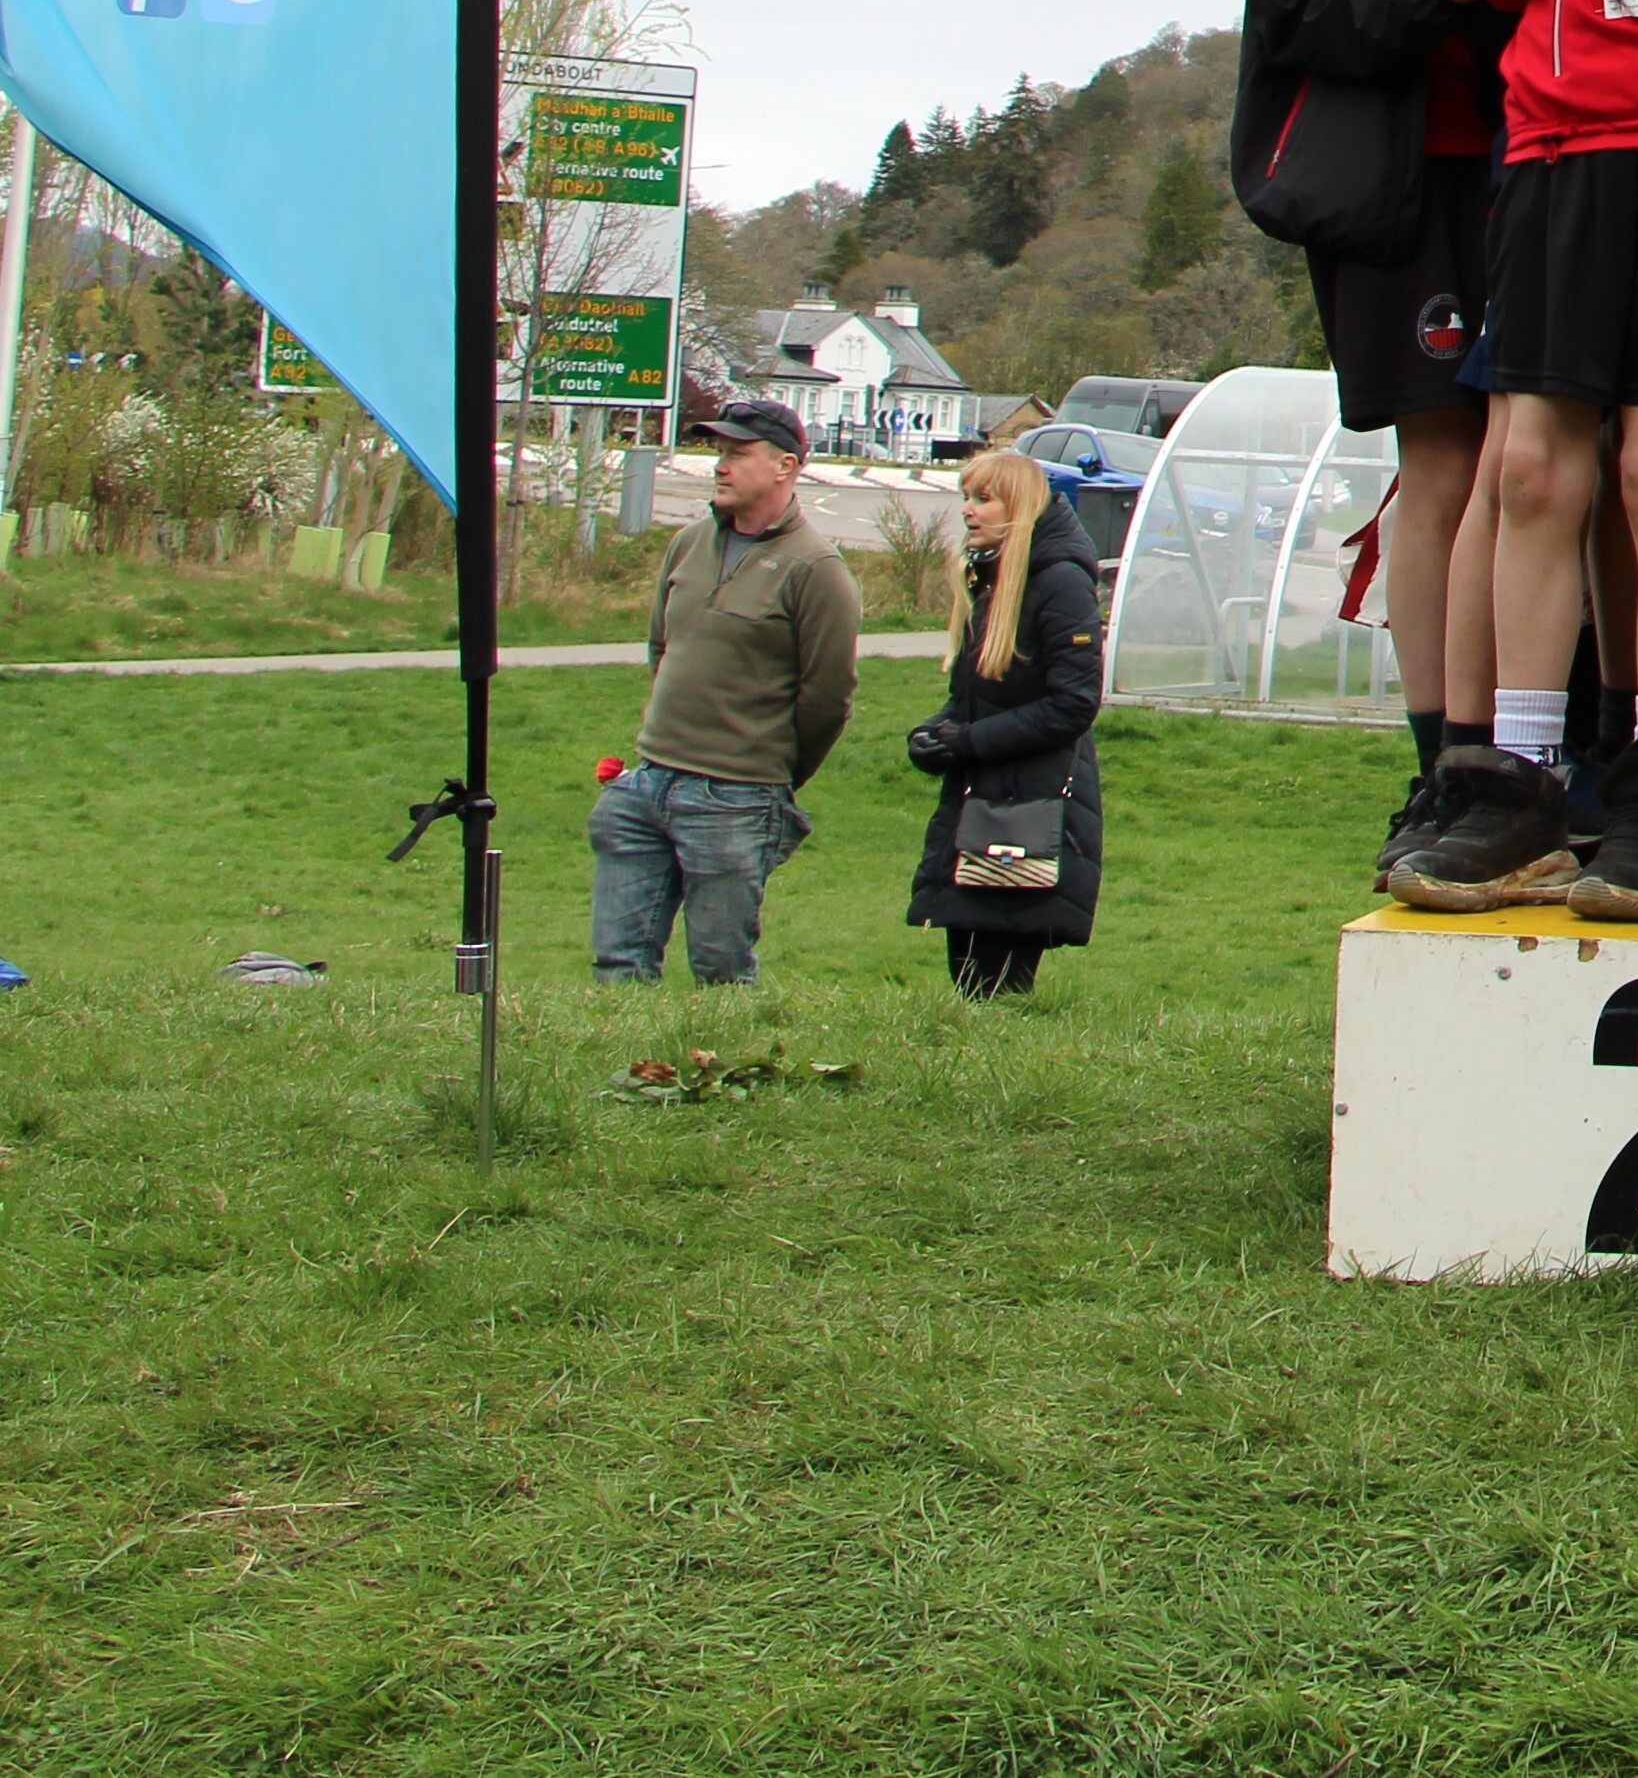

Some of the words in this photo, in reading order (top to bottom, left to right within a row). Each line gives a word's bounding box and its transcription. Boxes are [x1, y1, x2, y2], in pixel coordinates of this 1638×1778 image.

[571, 121, 621, 136] centre
[622, 165, 664, 181] route
[272, 345, 308, 361] Fort
[559, 377, 603, 392] route
